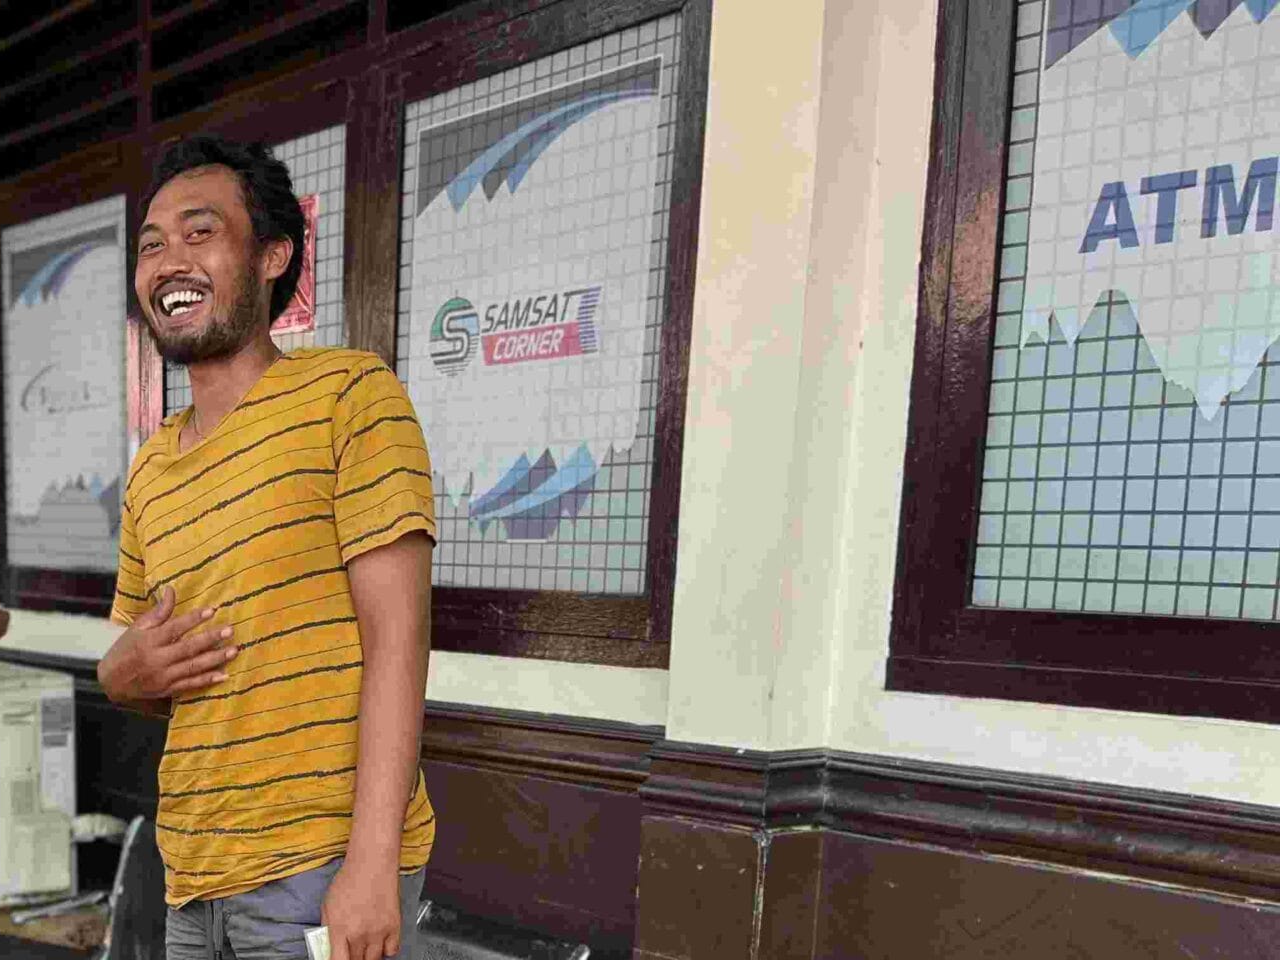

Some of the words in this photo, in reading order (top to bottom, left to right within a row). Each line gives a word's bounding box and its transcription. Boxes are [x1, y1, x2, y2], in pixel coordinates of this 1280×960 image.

[1078, 156, 1279, 254] ATM
[481, 287, 589, 334] SAMSAT
[492, 327, 564, 361] CORNER
